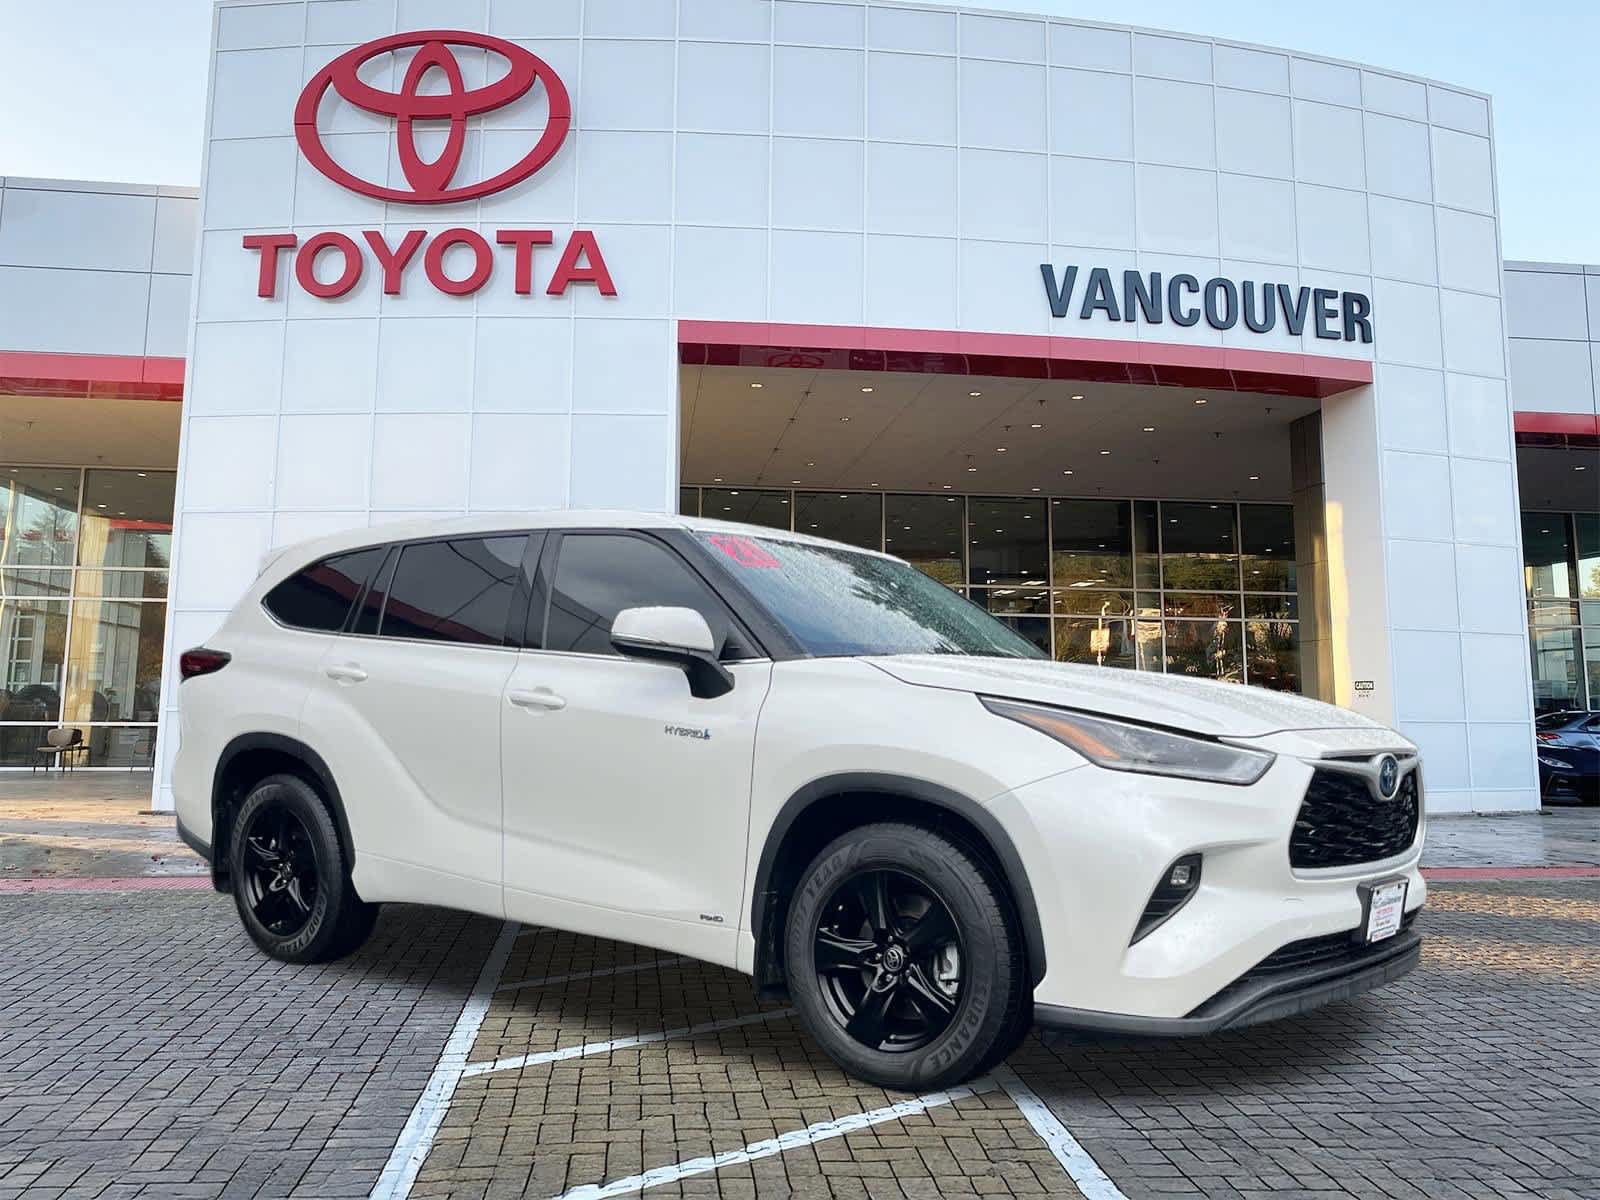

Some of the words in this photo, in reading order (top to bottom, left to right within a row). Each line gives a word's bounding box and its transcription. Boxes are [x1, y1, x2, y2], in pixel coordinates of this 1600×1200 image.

[243, 228, 618, 298] TOYOTA
[1040, 264, 1373, 343] VANCOUVER
[664, 725, 704, 739] HYBRID
